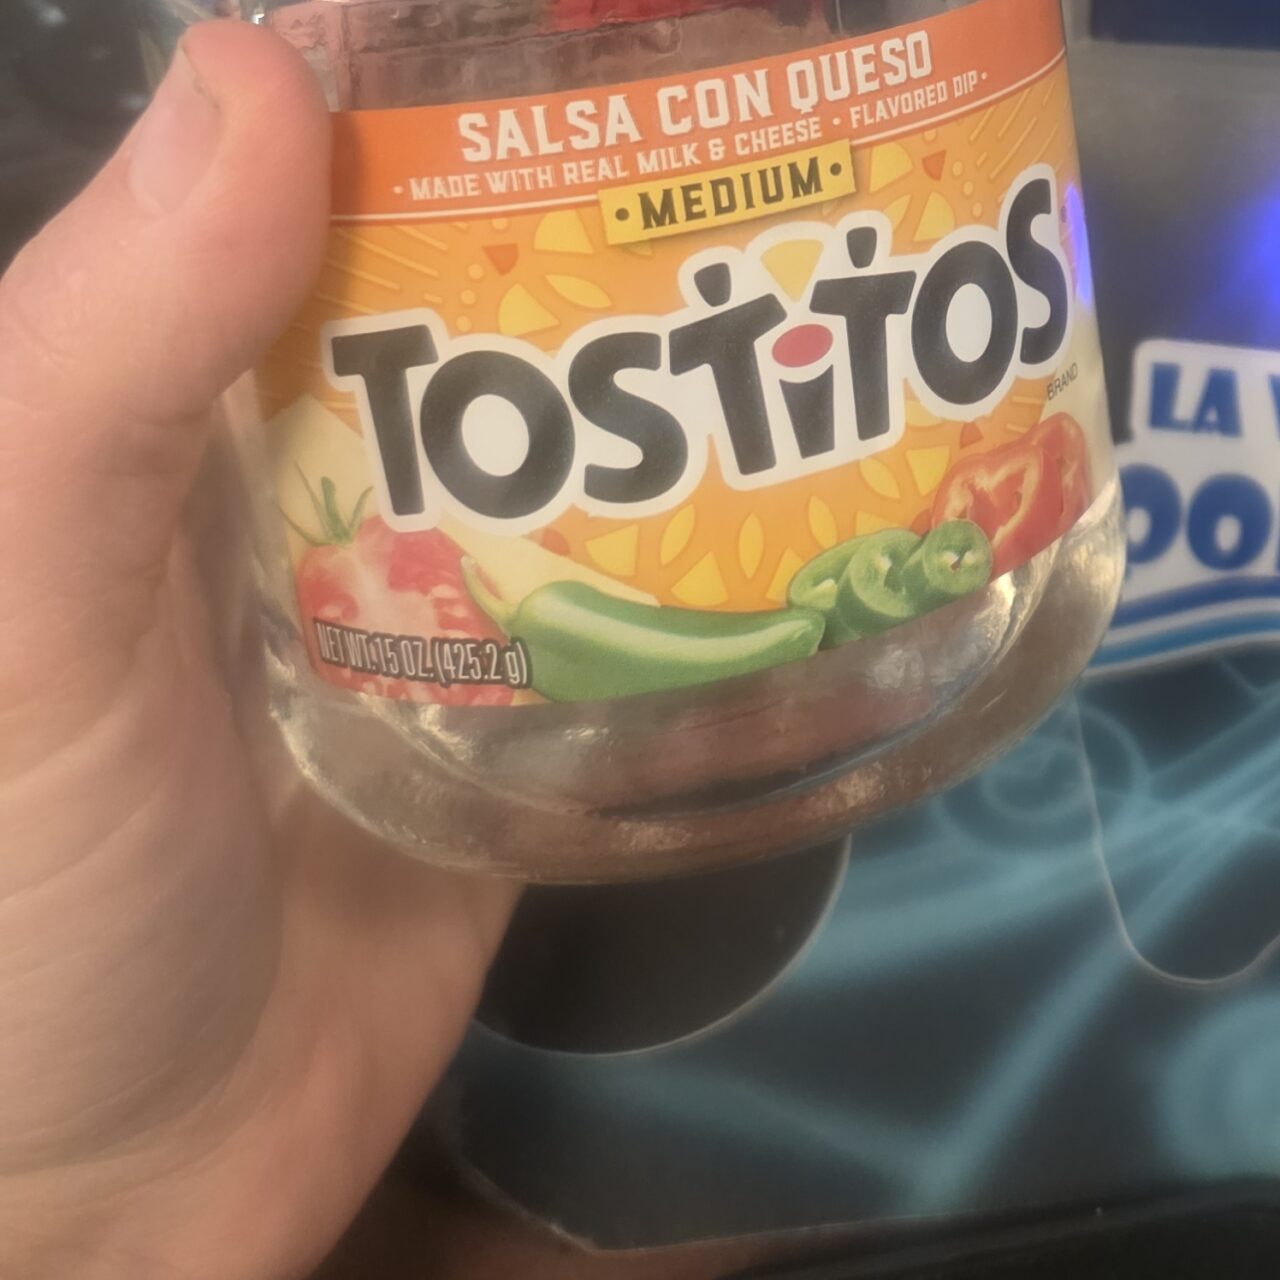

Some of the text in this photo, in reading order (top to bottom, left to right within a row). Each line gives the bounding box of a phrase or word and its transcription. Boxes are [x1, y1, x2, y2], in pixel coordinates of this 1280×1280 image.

[457, 30, 932, 162] SALSA CON QUESO
[409, 70, 979, 200] MADE WITH REAL MILK & CHEESE FLAVORED DIP
[637, 156, 823, 230] MEDIUM
[1047, 361, 1078, 401] BRAND
[1147, 361, 1242, 438] LA
[316, 622, 343, 661] NET
[376, 637, 400, 674] 15
[434, 641, 502, 682] (425.2
[505, 642, 528, 684] g)
